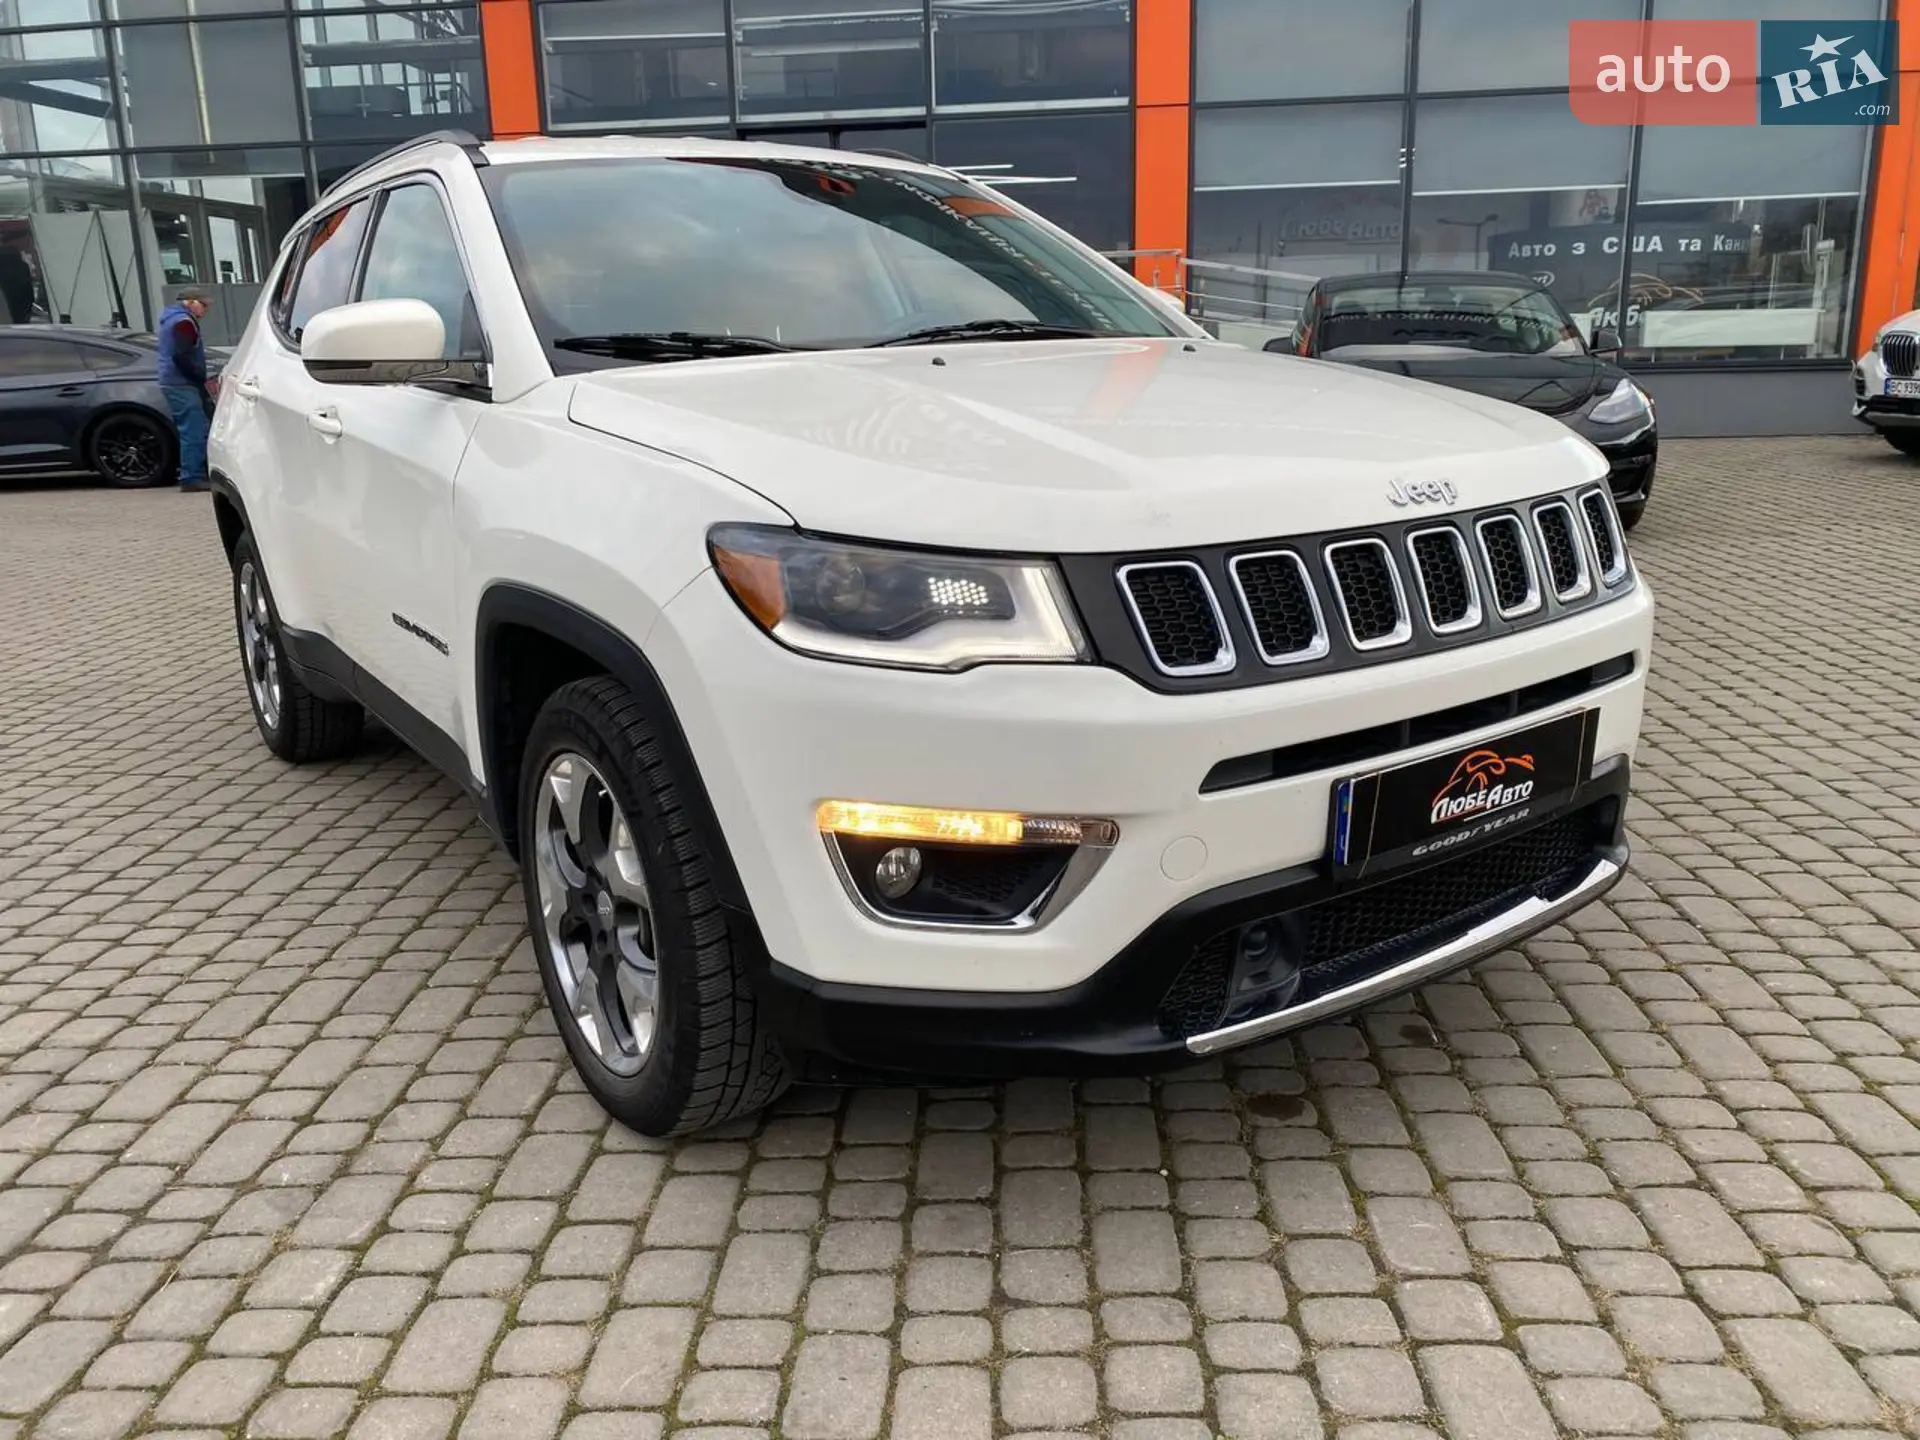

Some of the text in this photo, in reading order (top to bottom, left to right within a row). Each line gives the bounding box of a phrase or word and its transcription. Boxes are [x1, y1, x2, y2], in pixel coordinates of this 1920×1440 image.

[1507, 241, 1557, 258] Авто
[1678, 238, 1702, 252] та
[1385, 479, 1457, 506] Jeep
